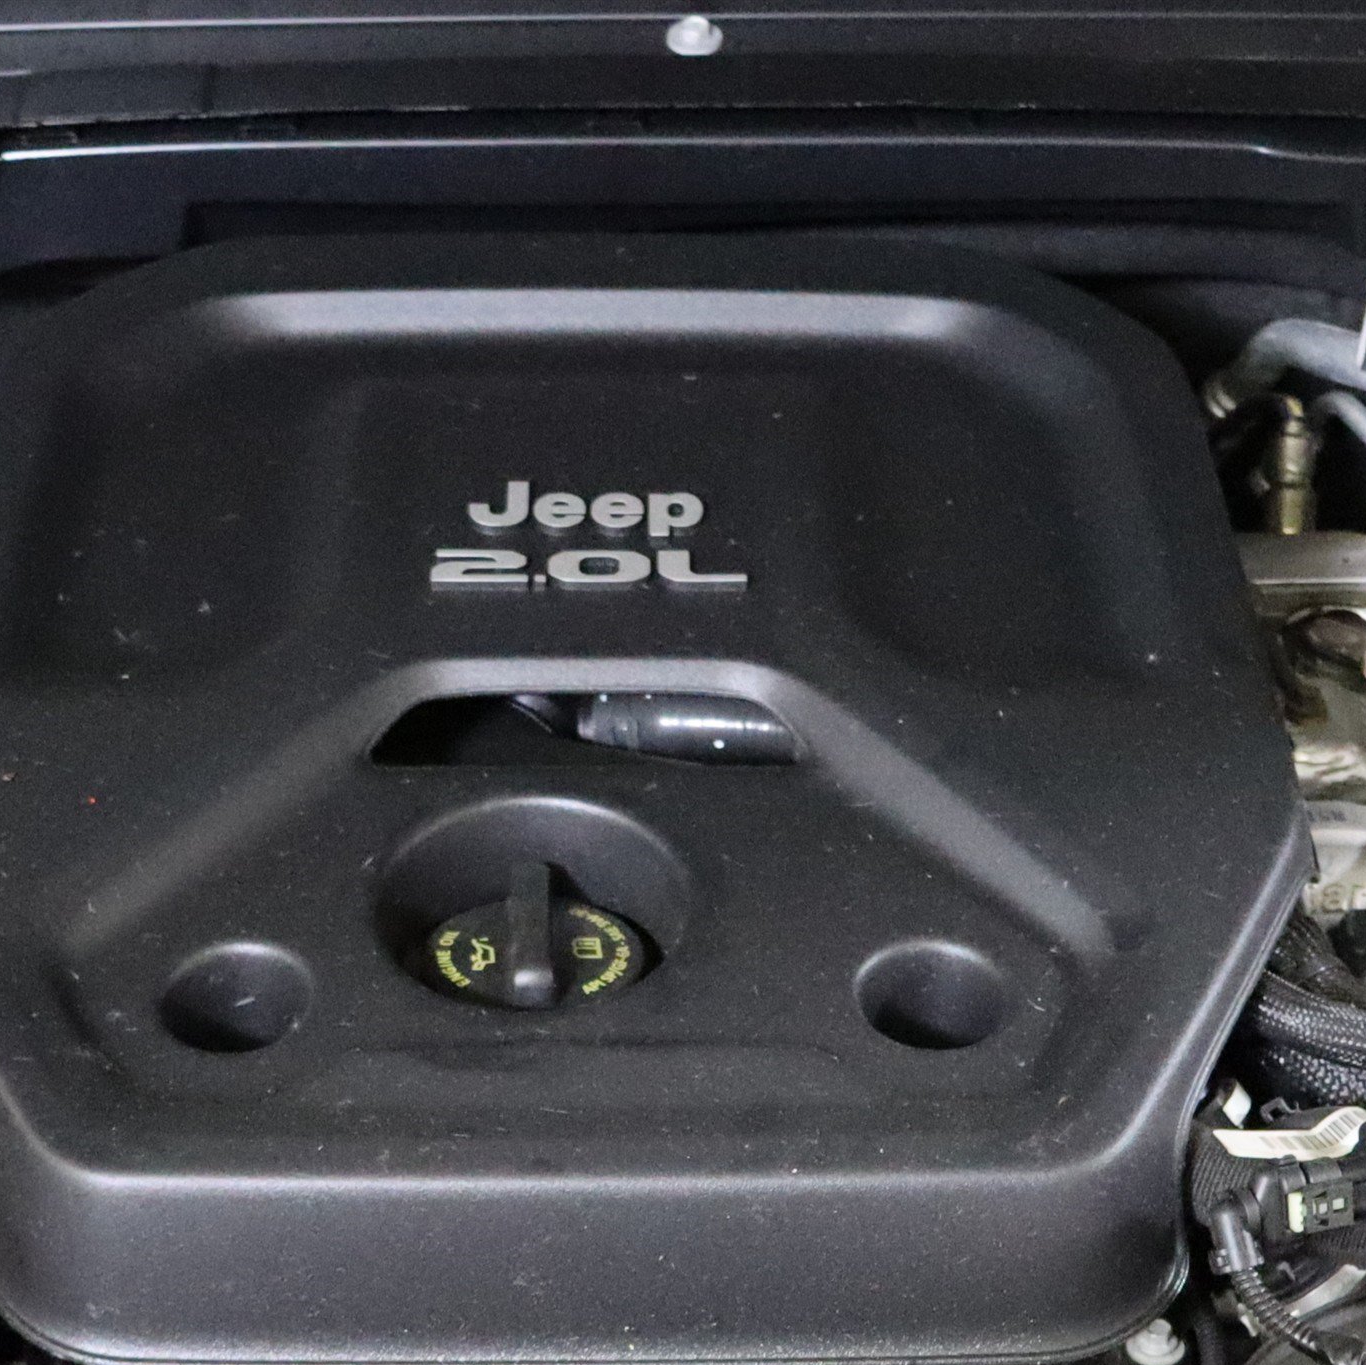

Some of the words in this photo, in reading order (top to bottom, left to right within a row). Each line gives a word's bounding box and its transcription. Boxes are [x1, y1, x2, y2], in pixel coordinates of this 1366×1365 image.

[467, 480, 705, 543] Jeep
[429, 548, 748, 590] 2.0L
[439, 930, 461, 947] OIL
[436, 949, 471, 988] ENGINE
